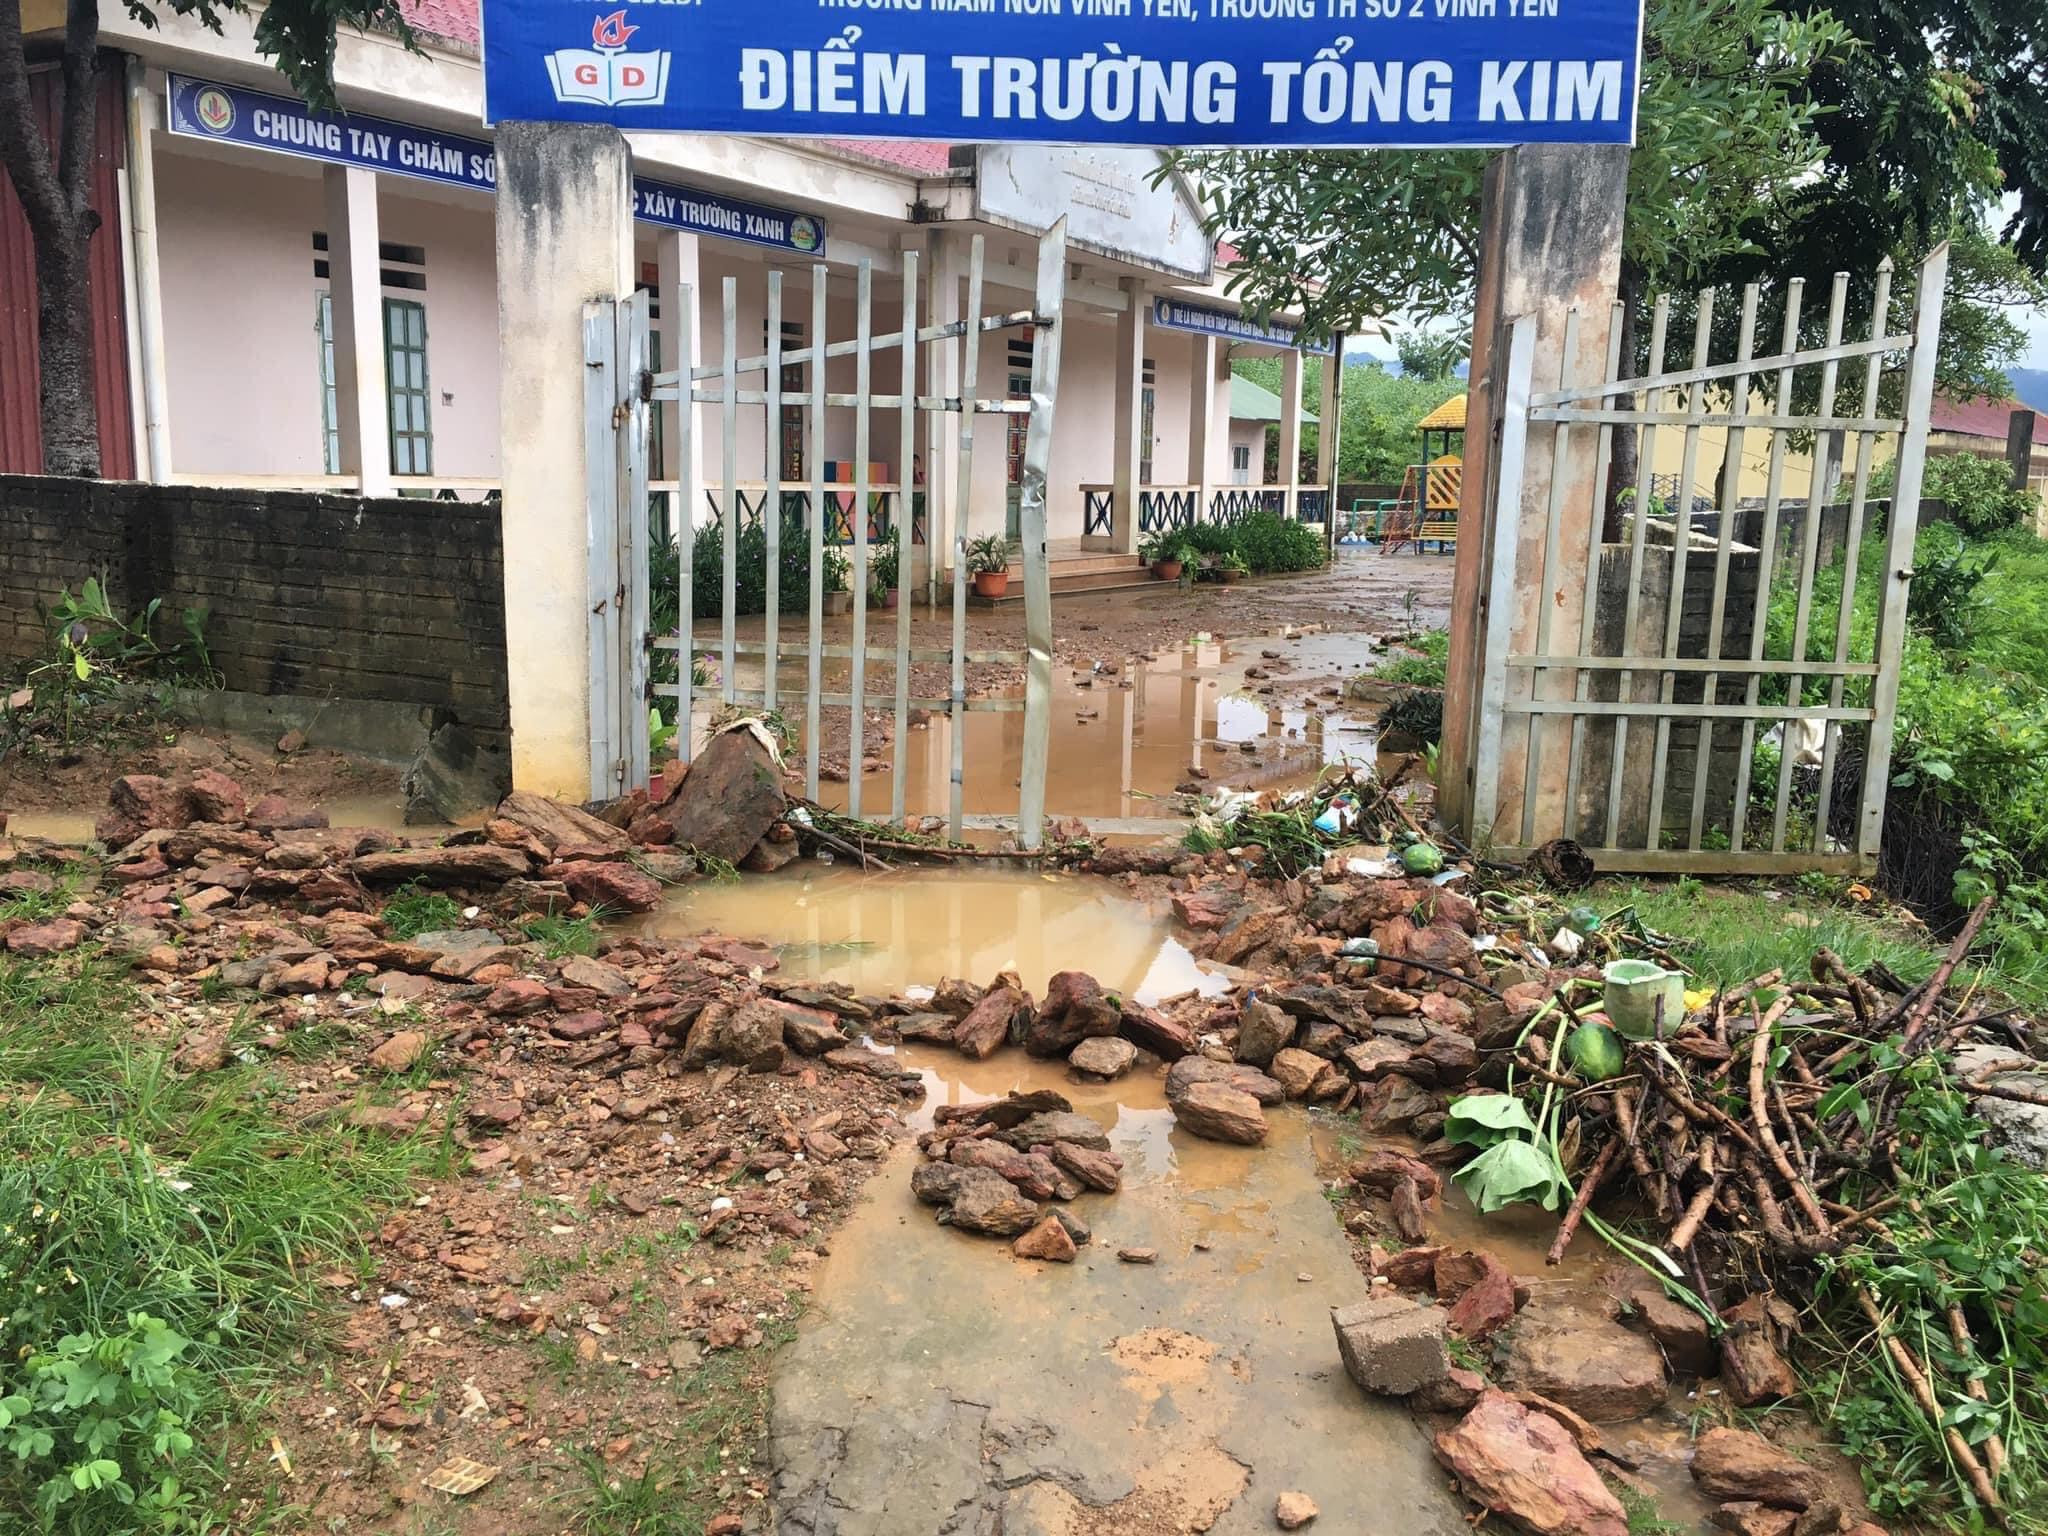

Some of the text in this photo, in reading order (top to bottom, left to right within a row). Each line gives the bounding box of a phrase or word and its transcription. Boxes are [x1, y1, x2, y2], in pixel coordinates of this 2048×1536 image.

[575, 64, 645, 87] G D
[739, 25, 1623, 124] ĐIỂM TRƯỜNG TỔNG KIM
[253, 110, 342, 152] CHUNG
[347, 128, 391, 161] TAY
[399, 138, 464, 177] CHĂM
[644, 190, 676, 219] XÂY
[680, 200, 741, 233] TRƯỜNG
[745, 213, 785, 242] XANH
